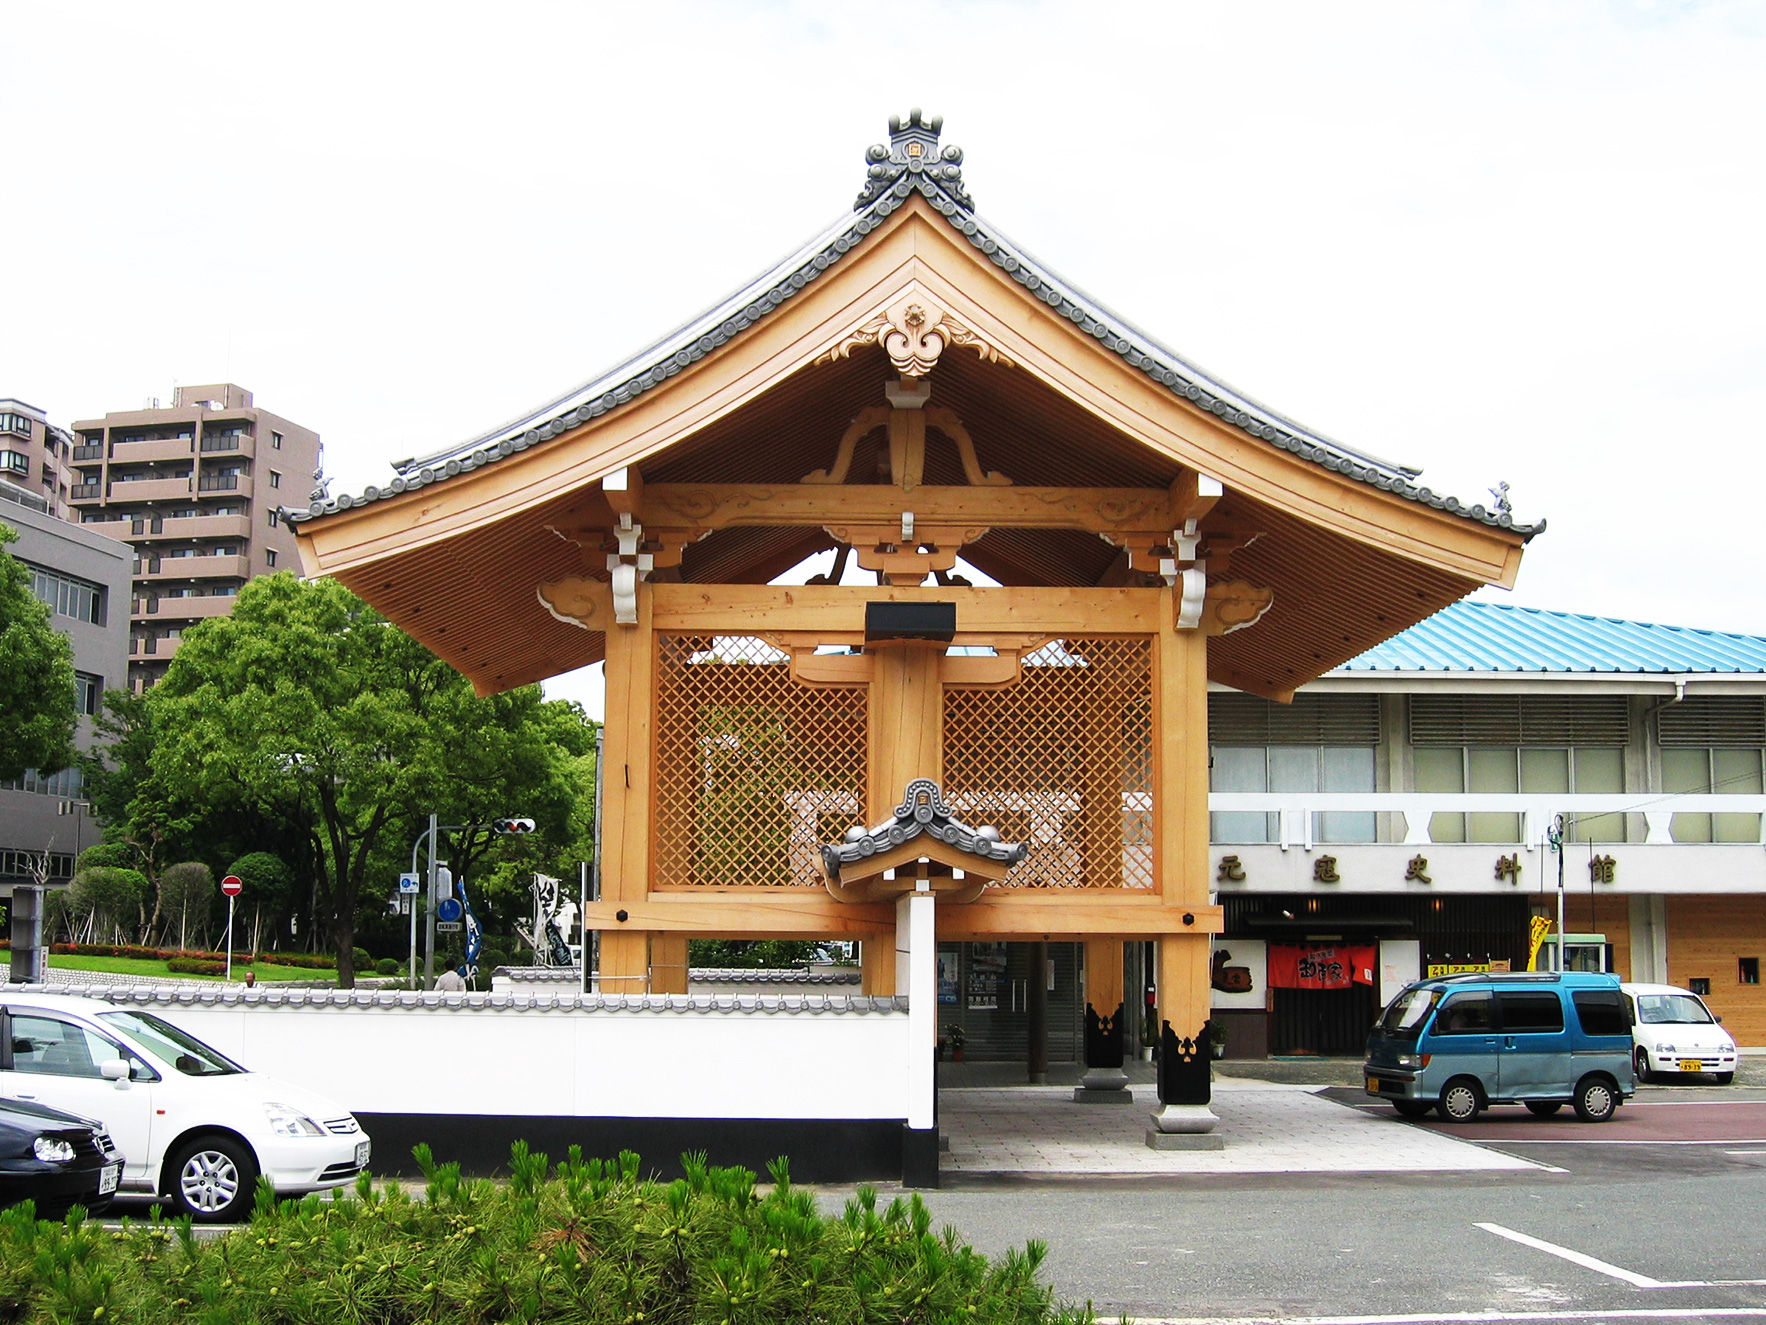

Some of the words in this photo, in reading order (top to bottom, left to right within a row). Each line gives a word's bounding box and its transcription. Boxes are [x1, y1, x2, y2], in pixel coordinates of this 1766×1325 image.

[1217, 852, 1617, 886] 元寇史料館
